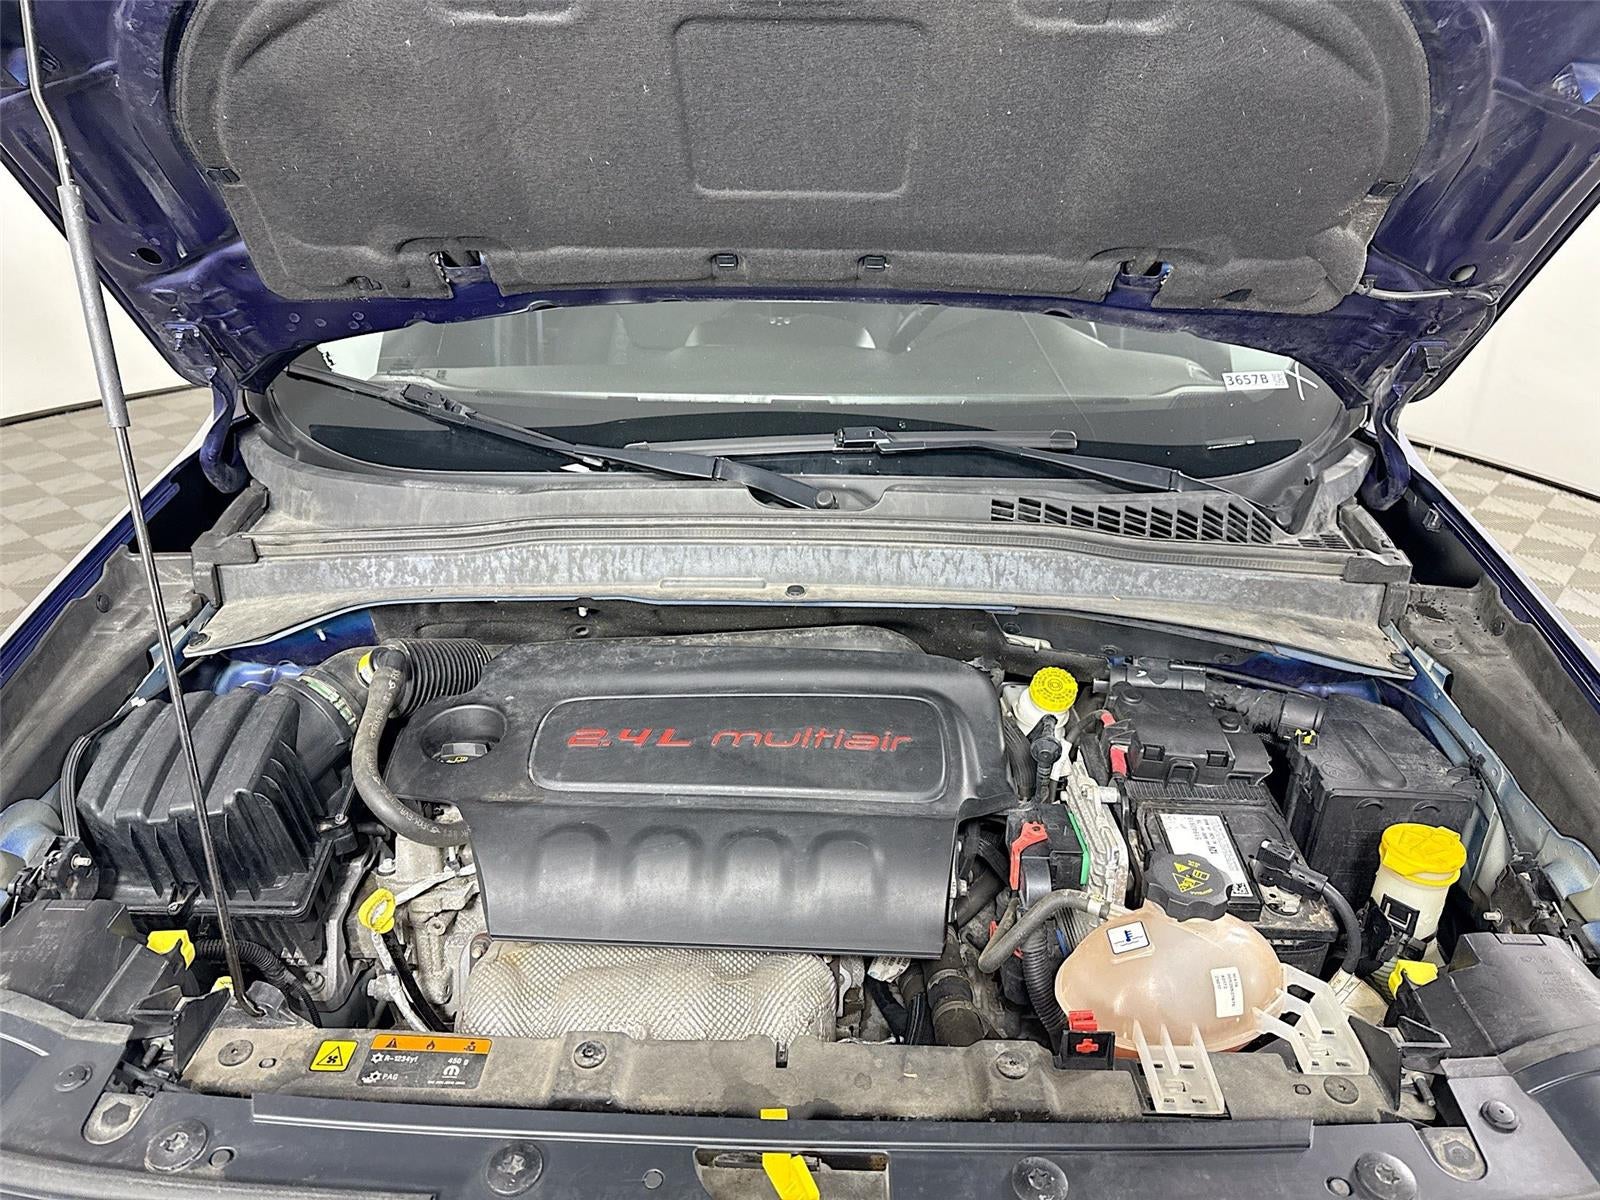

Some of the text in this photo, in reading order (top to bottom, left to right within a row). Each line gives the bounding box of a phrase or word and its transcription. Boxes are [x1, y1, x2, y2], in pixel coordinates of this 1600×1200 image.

[1225, 374, 1269, 386] 3657B
[567, 727, 913, 752] 2.4L multiair
[382, 1073, 399, 1081] PAG
